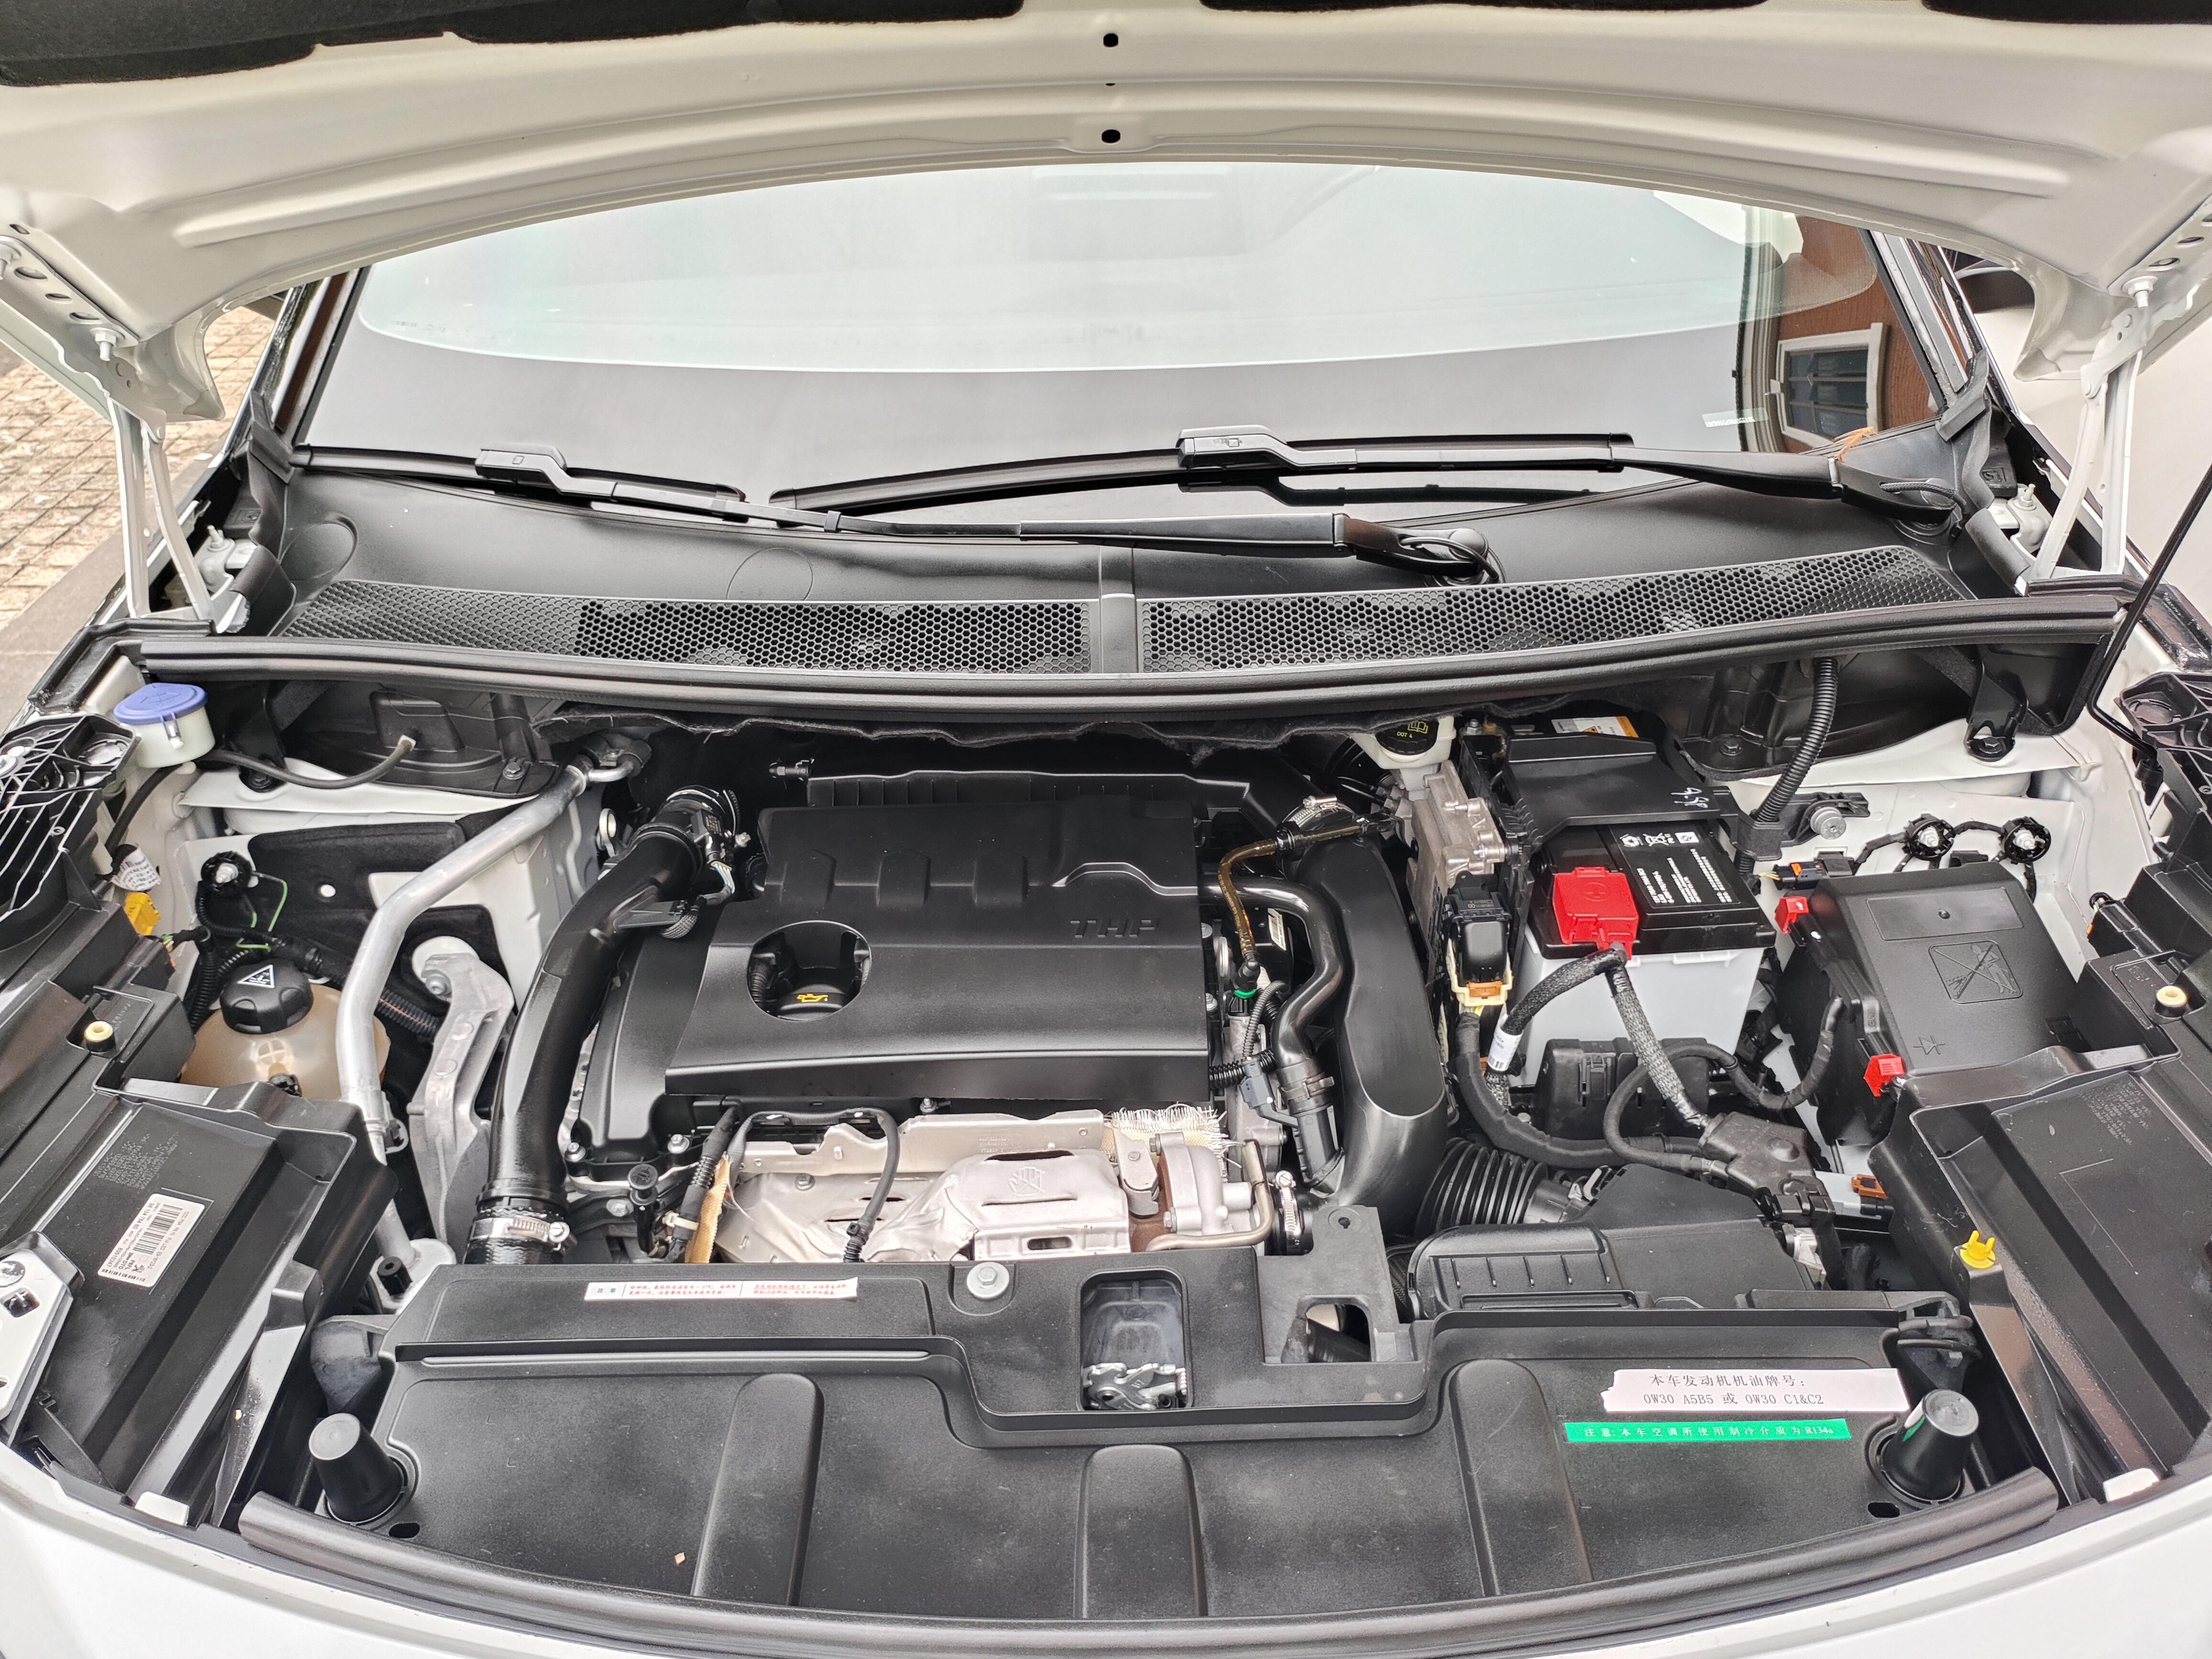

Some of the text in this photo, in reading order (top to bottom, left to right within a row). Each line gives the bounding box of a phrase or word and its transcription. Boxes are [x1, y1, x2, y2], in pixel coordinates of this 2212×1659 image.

[1070, 919, 1159, 938] THP
[105, 1247, 123, 1268] 89910347
[1649, 1374, 1805, 1388] 本车发动机机油牌号：
[1644, 1393, 1824, 1405] 0W30 A5B5 或 0W30 C1&C2
